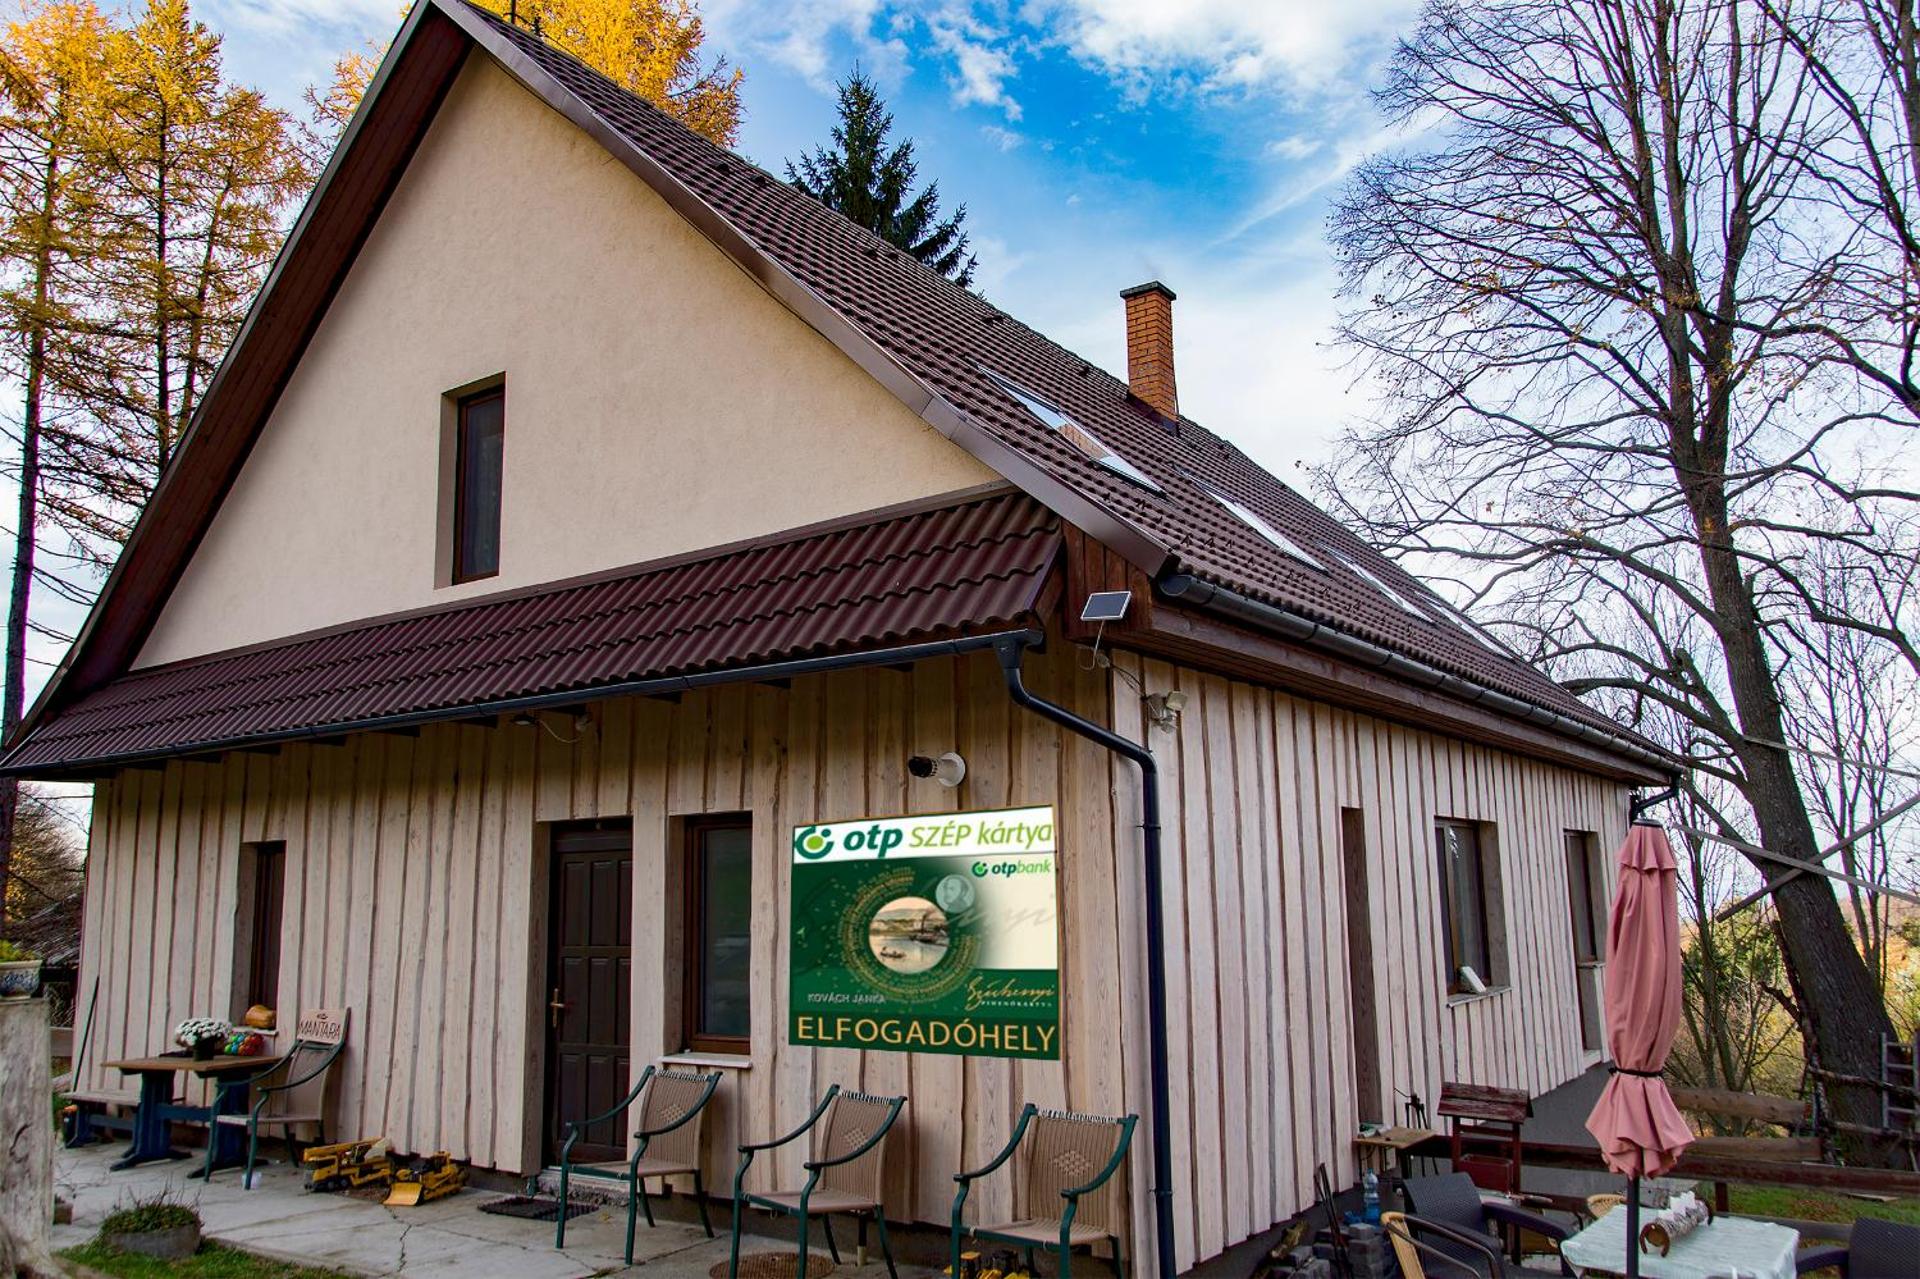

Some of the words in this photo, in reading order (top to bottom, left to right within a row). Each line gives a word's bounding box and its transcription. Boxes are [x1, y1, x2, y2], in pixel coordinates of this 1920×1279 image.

[843, 824, 903, 858] otp
[909, 820, 971, 848] SZÉP
[977, 820, 1052, 850] kártya
[798, 1015, 1055, 1052] ELFOGADÓHELY
